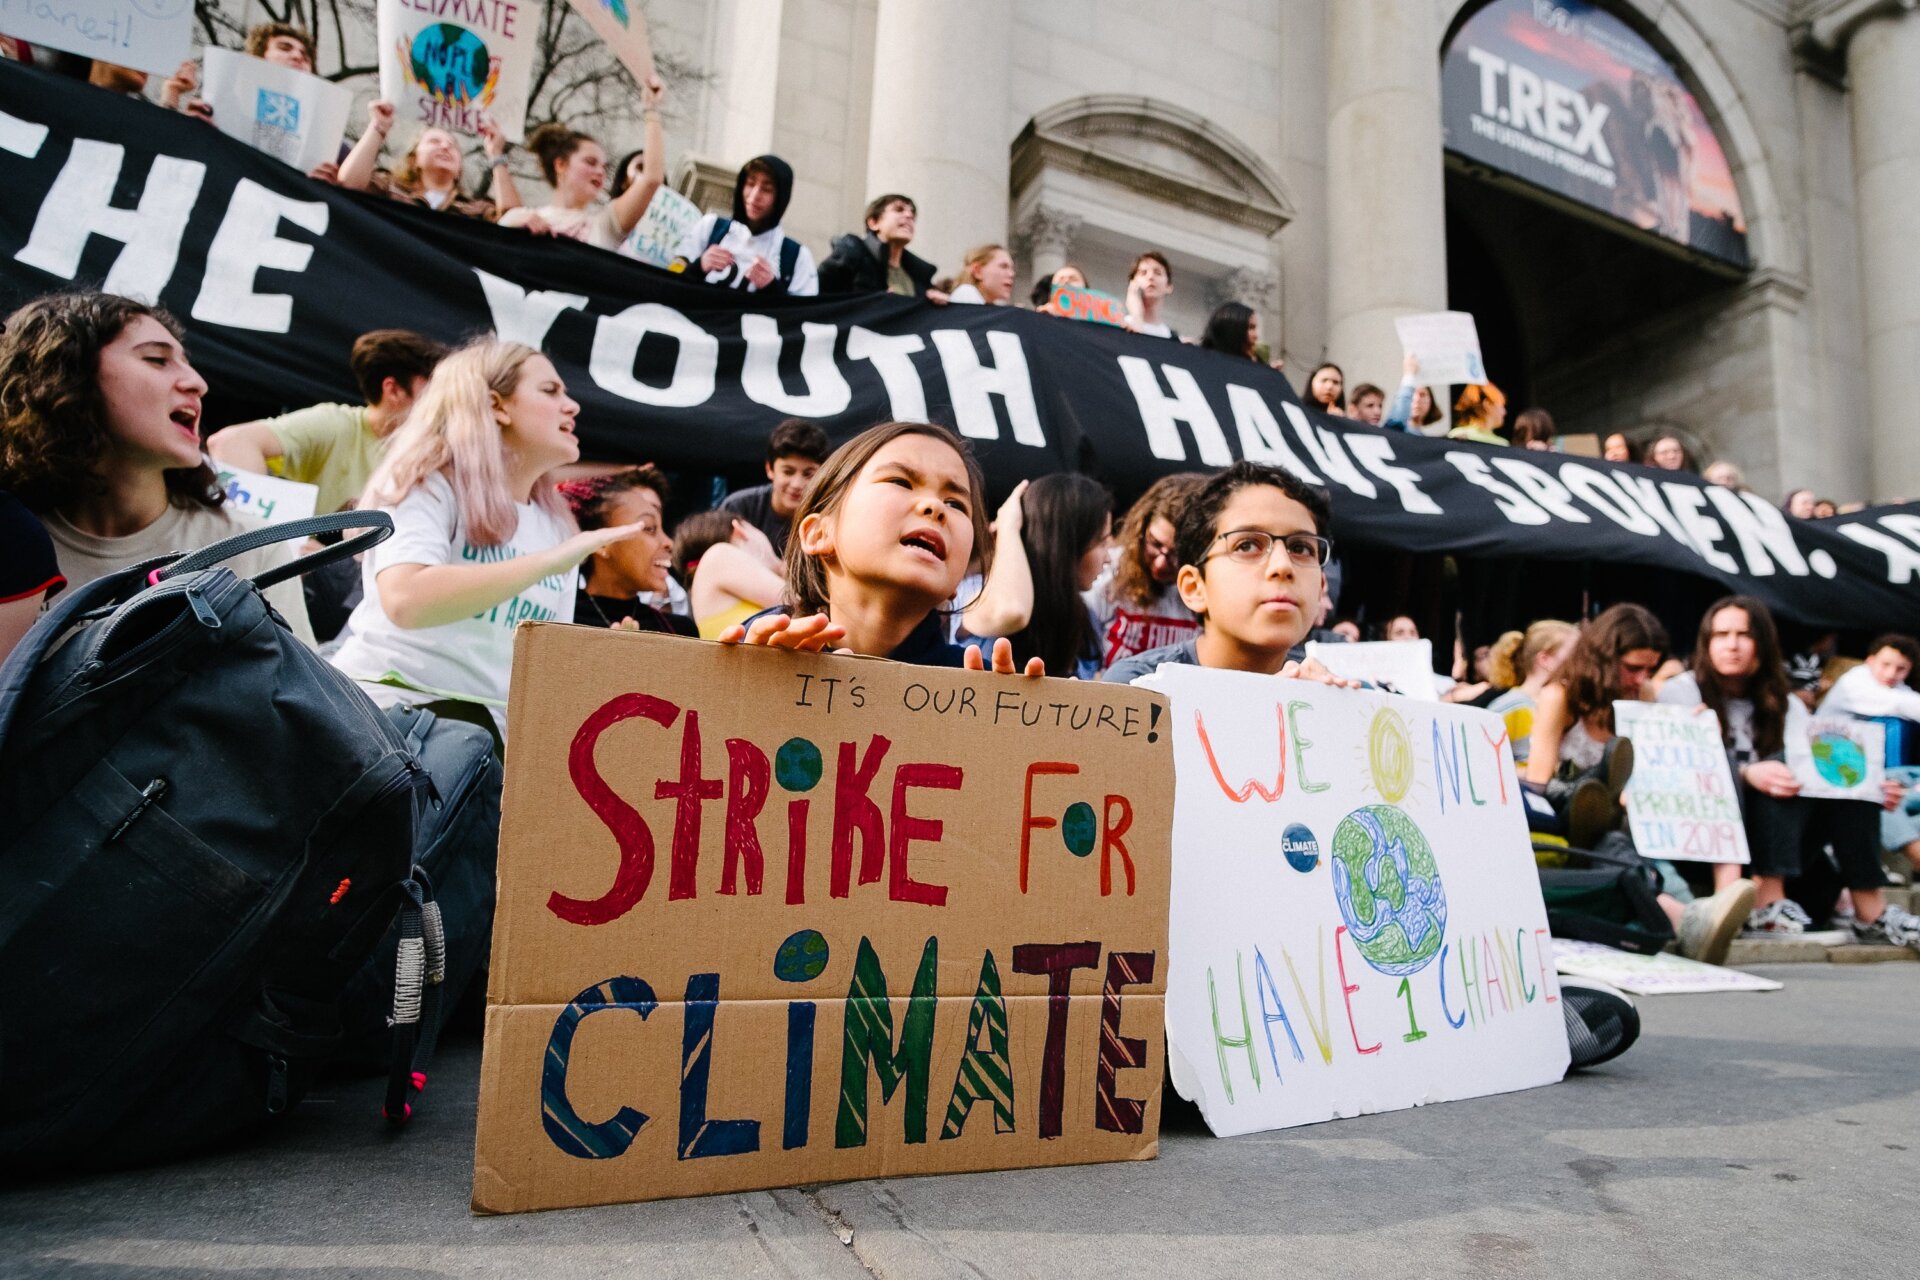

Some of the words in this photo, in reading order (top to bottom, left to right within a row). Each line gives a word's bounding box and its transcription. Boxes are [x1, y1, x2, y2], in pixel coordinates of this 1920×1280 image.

[0, 0, 132, 48] anet!
[400, 0, 519, 39] MATE
[1468, 45, 1615, 167] T.REX
[0, 110, 329, 334] HE
[475, 266, 1047, 448] YOUTH
[1116, 354, 1445, 515] HAVE
[1444, 450, 1837, 580] SPOKEN.
[902, 682, 978, 718] OUR
[993, 690, 1163, 744] FUTURE!
[1193, 699, 1332, 804] WE
[1368, 704, 1510, 815] ONLY
[1019, 761, 1138, 897] FOR
[1282, 840, 1319, 853] CLIMATE
[1639, 819, 1677, 850] IN
[1680, 820, 1741, 858] 2019
[1206, 923, 1383, 1106] HAVE
[1397, 976, 1428, 1044] 1
[1439, 926, 1558, 1032] CHANCE
